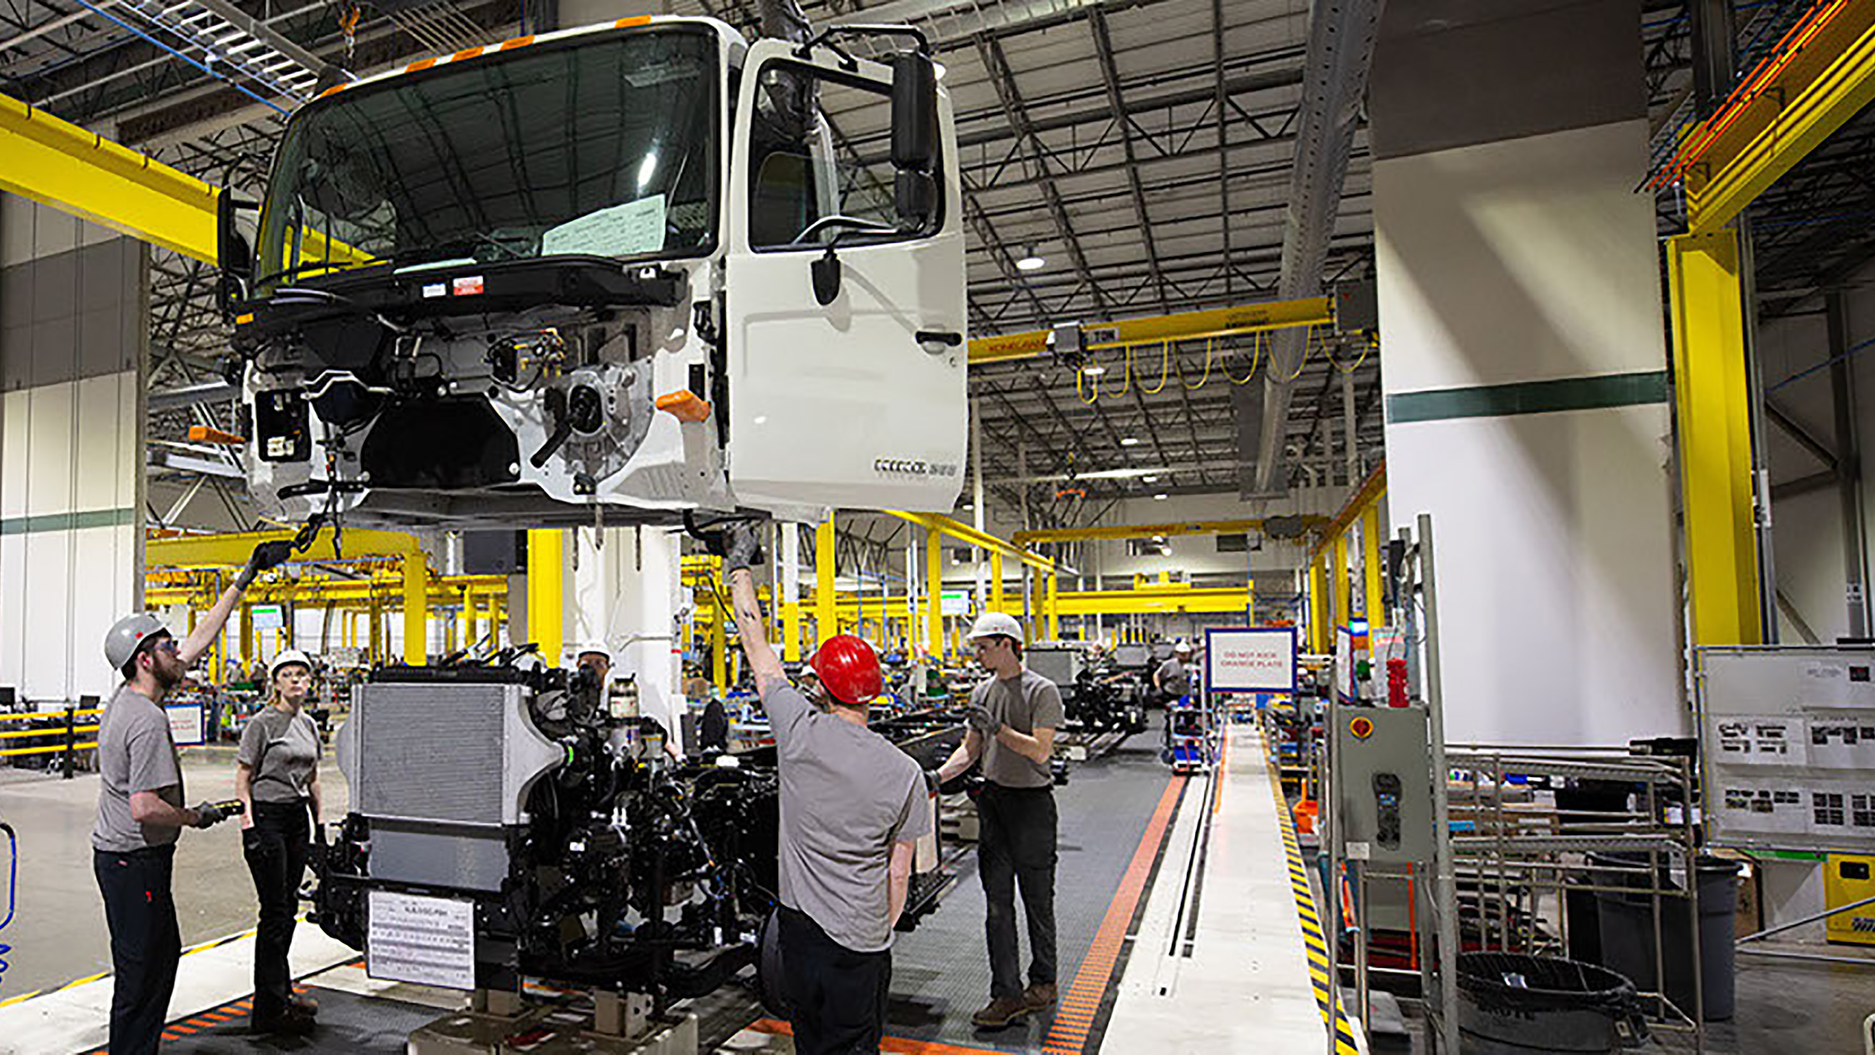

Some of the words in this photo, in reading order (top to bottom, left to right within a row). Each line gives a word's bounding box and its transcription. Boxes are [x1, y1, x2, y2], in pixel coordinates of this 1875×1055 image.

[1223, 651, 1236, 659] DO
[1238, 651, 1255, 659] NOT
[1220, 660, 1255, 668] ORANGE
[1257, 660, 1283, 668] PLATE
